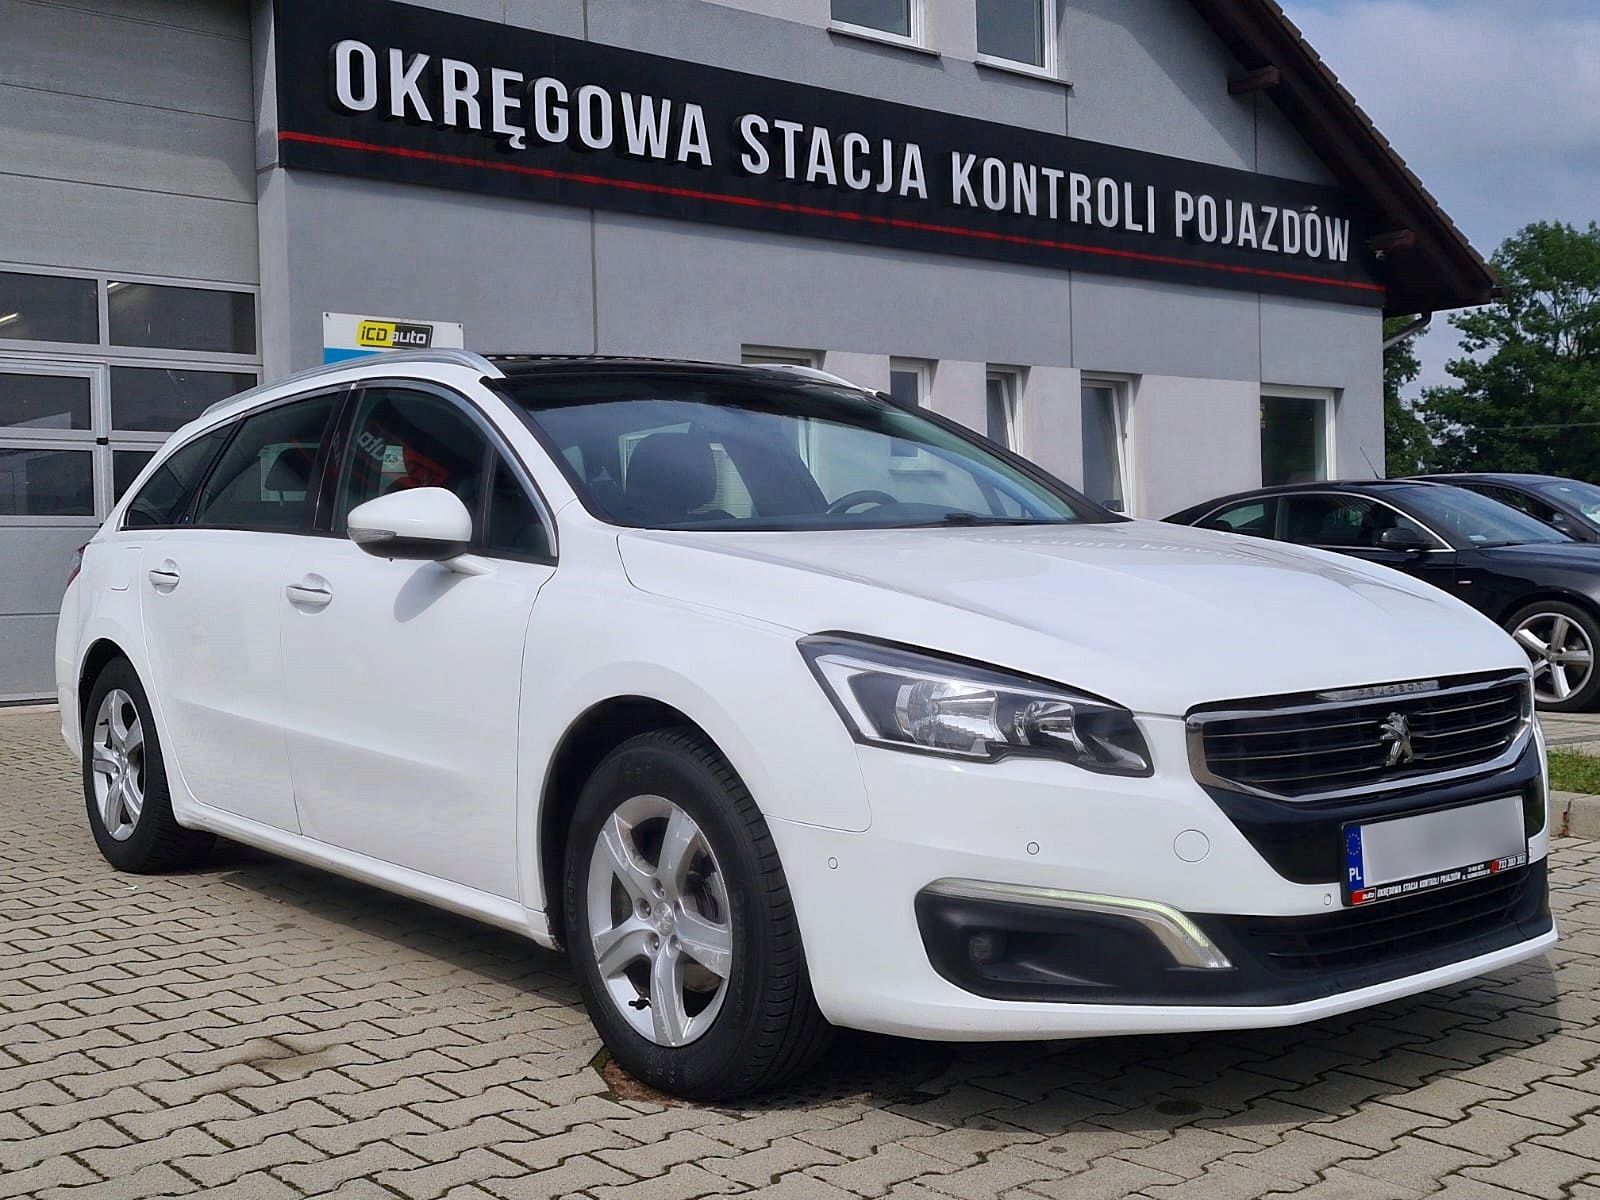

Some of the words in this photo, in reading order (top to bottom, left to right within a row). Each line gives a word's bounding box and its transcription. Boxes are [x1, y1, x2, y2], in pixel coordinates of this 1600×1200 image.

[334, 39, 713, 166] OKRĘGOWA
[739, 113, 928, 200] STACJA
[951, 151, 1155, 234] KONTROLI
[1175, 190, 1350, 262] POJAZDÓW
[1349, 867, 1362, 882] PL
